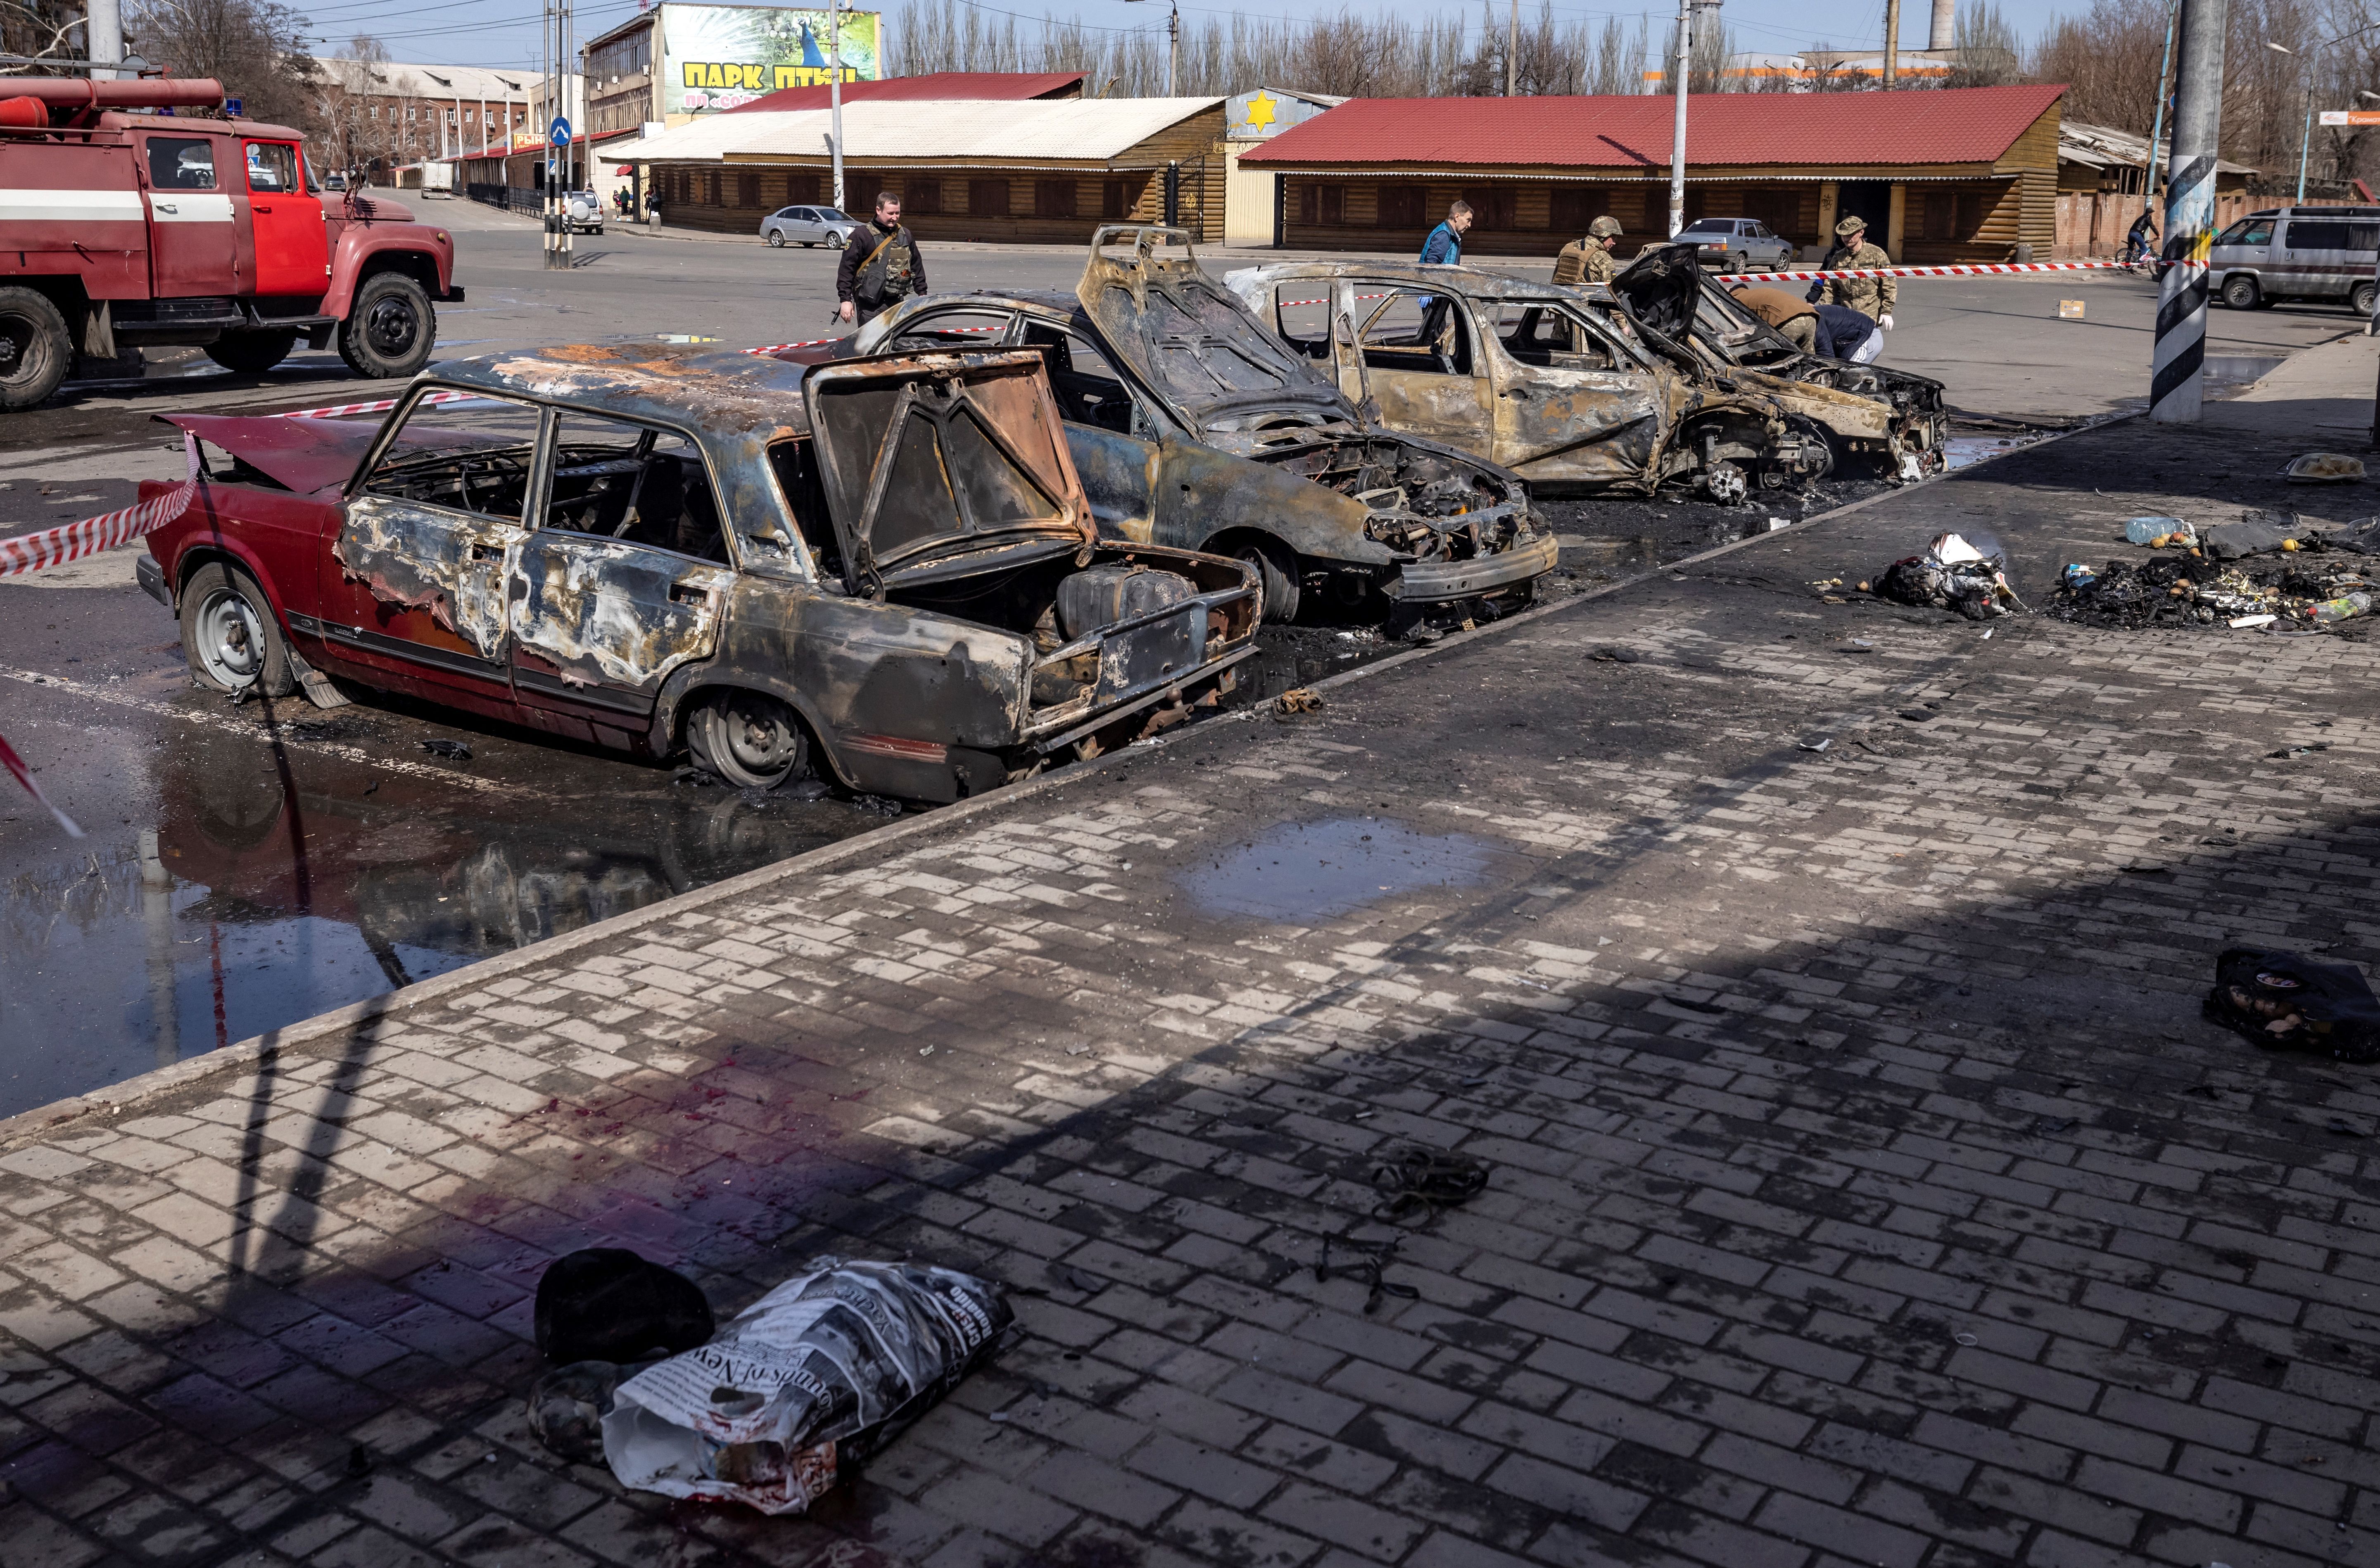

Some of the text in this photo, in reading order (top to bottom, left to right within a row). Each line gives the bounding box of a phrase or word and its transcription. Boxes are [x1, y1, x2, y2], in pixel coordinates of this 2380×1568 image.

[684, 62, 764, 89] ПАРК
[335, 628, 353, 638] LADA
[950, 1285, 993, 1340] Ronaldo
[736, 1363, 765, 1389] of
